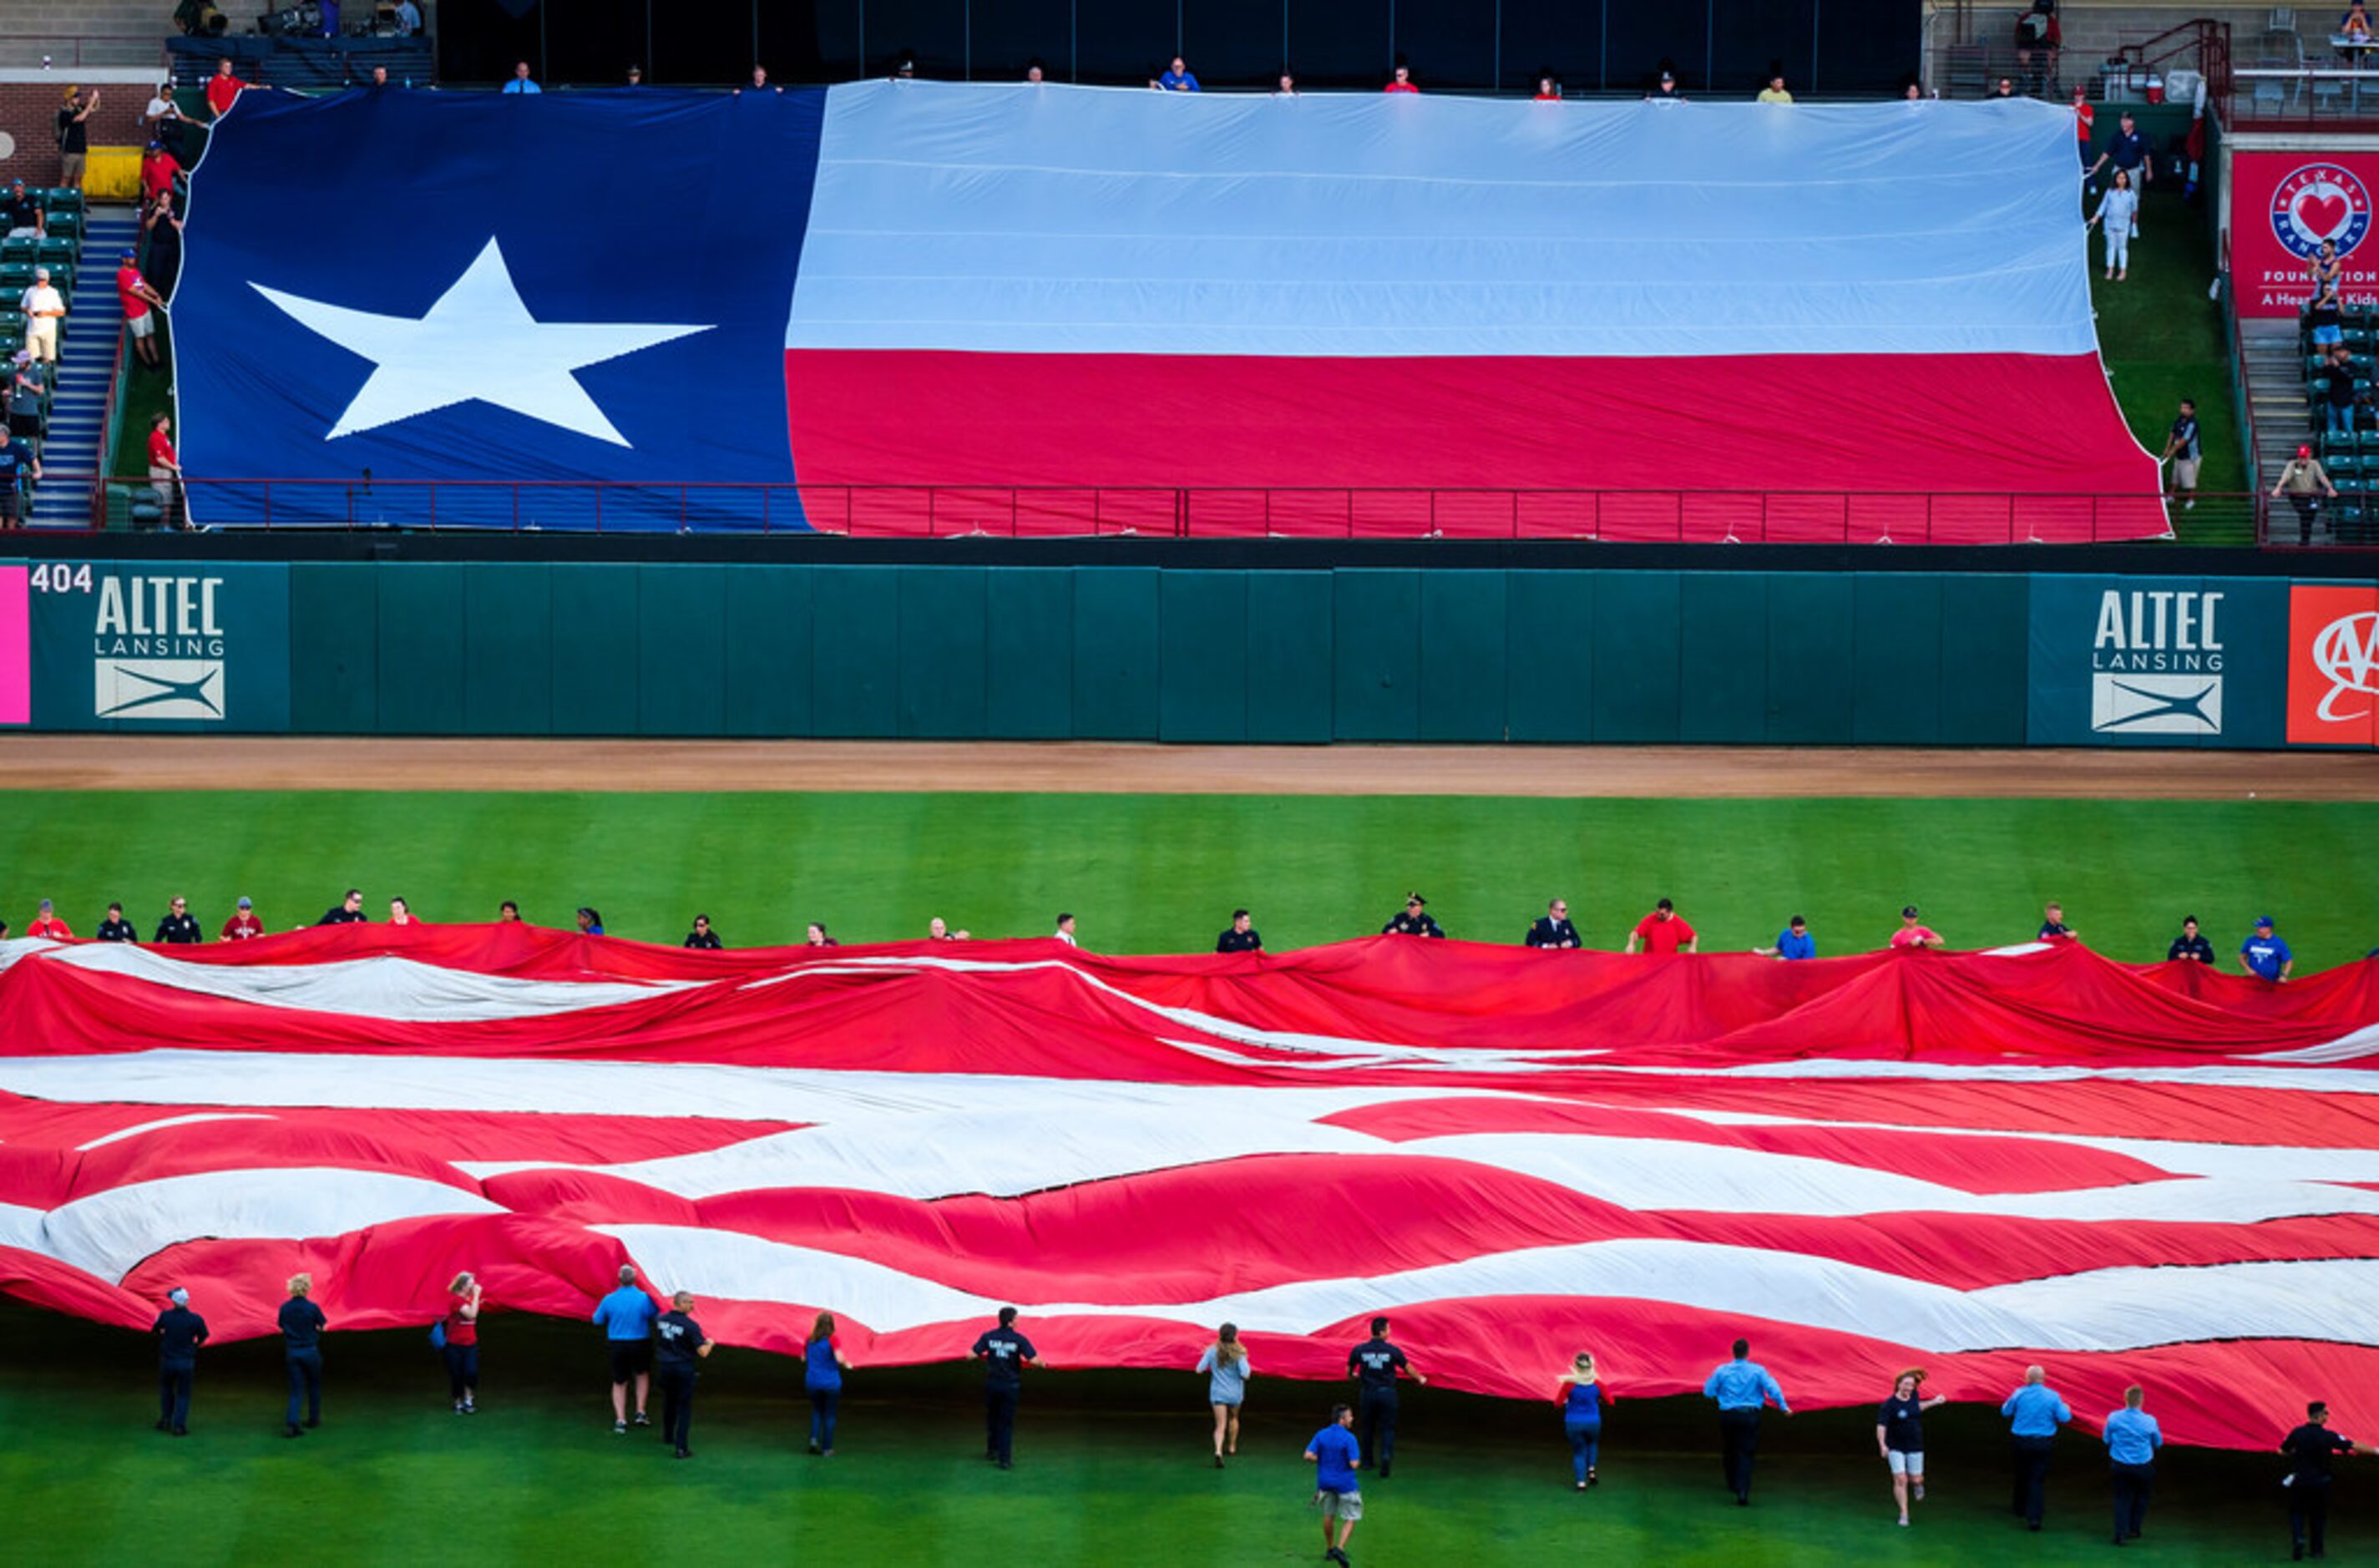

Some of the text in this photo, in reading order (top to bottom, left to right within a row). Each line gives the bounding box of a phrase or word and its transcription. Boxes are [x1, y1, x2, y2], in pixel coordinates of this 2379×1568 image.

[2285, 169, 2357, 195] TEXAS
[2262, 294, 2274, 306] A
[2276, 293, 2311, 306] Hear
[31, 563, 93, 593] 404
[95, 575, 224, 635] ALTEC
[2093, 589, 2225, 650] ALTEC
[94, 638, 225, 656] LANSING
[2093, 653, 2224, 671] LANSING
